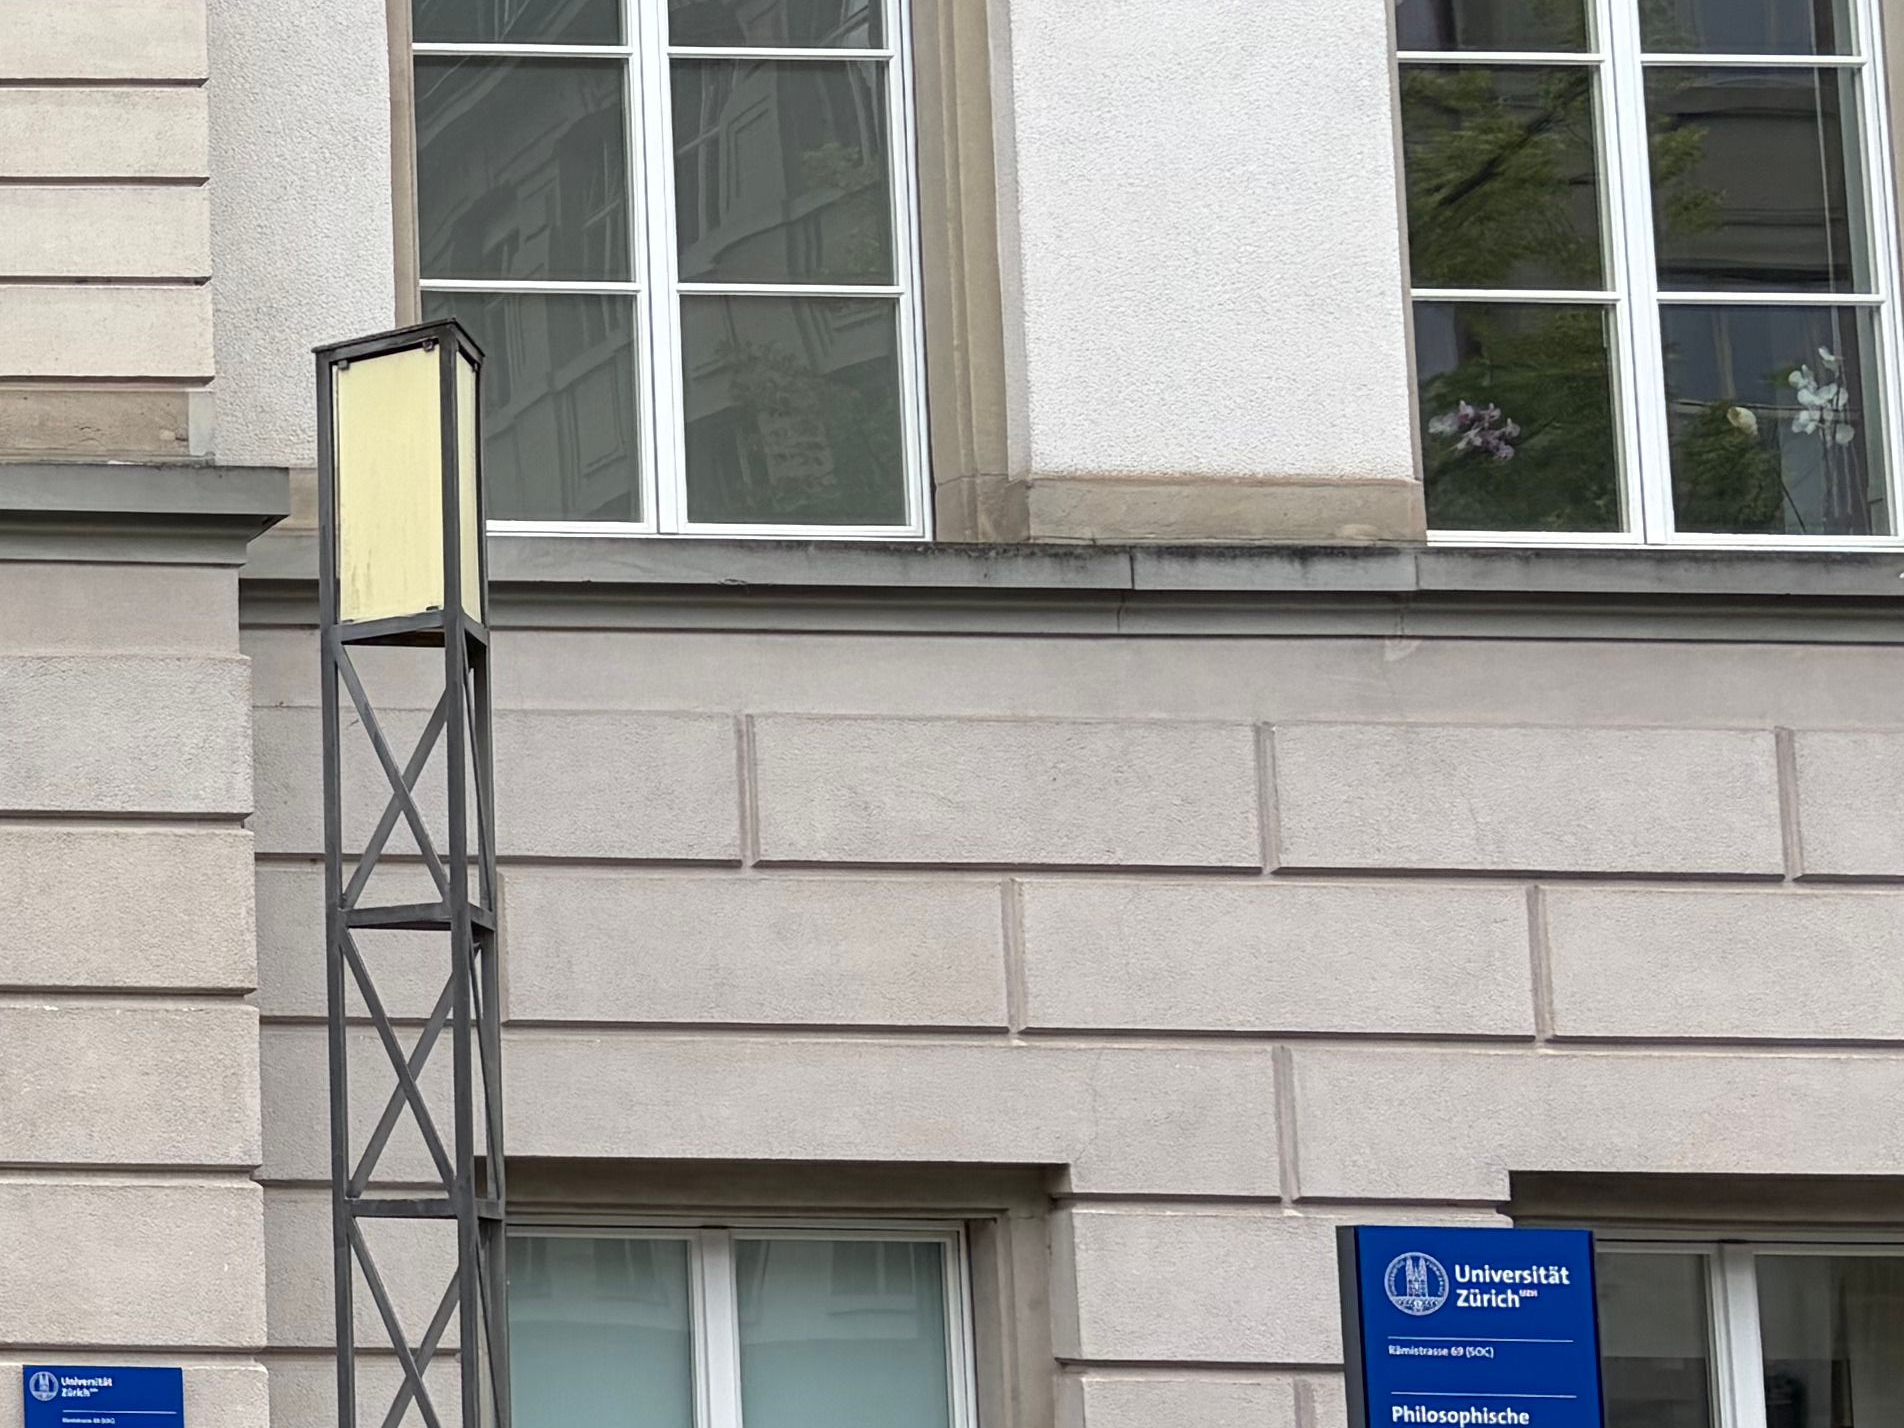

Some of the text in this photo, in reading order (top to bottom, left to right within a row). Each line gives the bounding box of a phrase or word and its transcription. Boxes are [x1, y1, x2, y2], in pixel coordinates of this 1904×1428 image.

[1454, 1264, 1570, 1285] Universität
[1456, 1288, 1521, 1308] Zürich
[1388, 1345, 1494, 1358] Rämistrasse 69 (SOC)
[61, 1377, 113, 1387] Universität
[61, 1388, 91, 1397] Zürich
[1392, 1405, 1530, 1428] Philosophische
